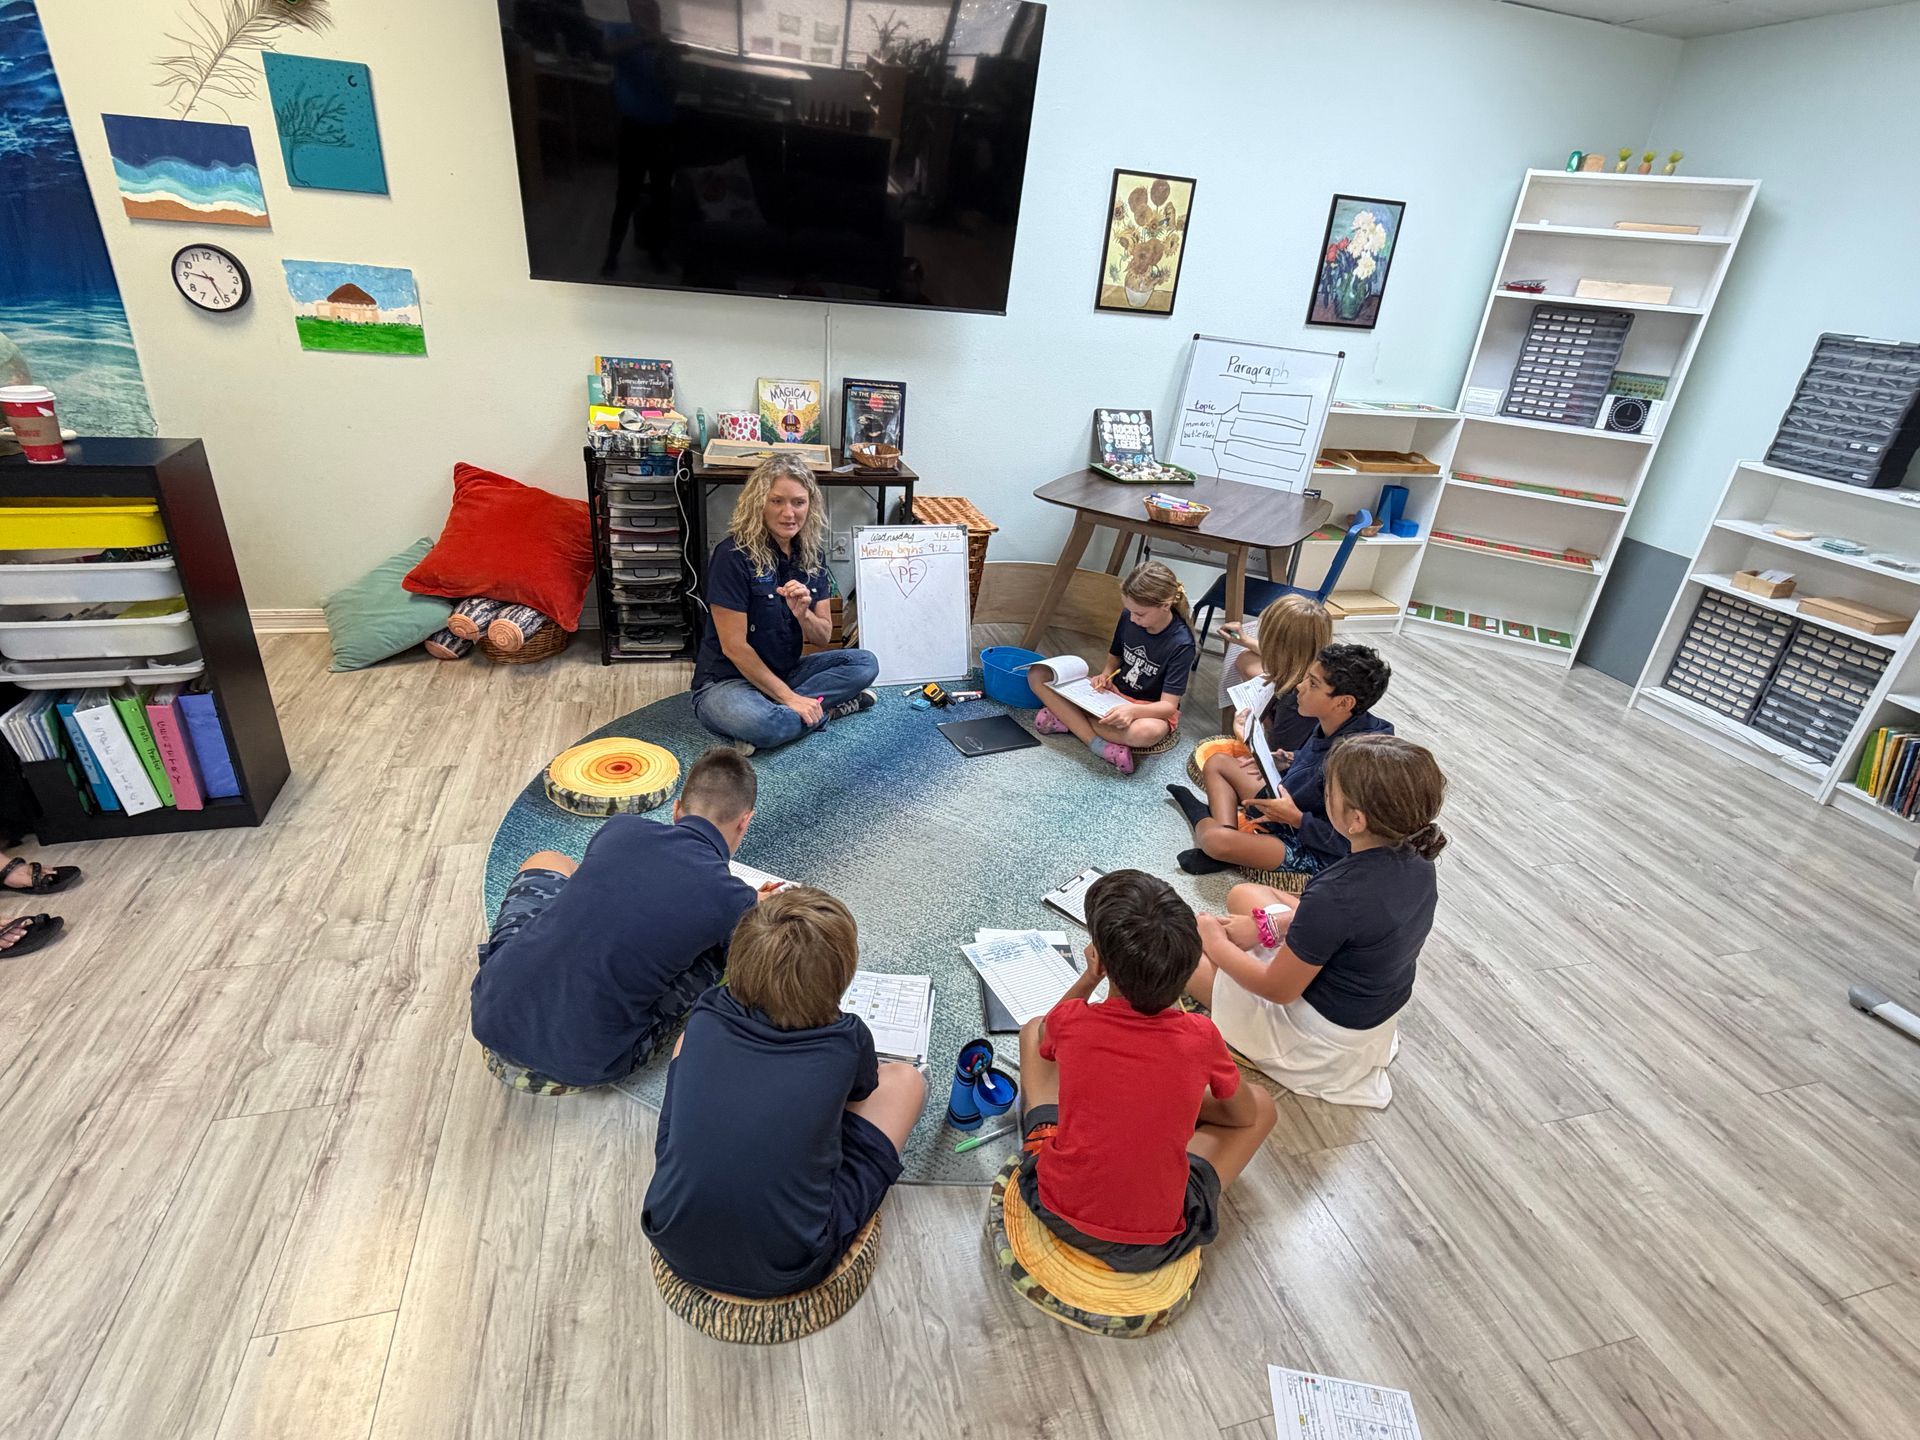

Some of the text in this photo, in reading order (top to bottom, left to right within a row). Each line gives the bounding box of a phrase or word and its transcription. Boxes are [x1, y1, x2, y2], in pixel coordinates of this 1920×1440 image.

[191, 254, 200, 262] 11
[202, 252, 212, 260] 12
[217, 256, 222, 264] 1
[183, 261, 193, 270] 10
[226, 265, 233, 273] 2
[183, 271, 190, 280] 9
[232, 276, 239, 285] 3
[190, 283, 197, 292] 8
[200, 291, 206, 300] 7
[224, 294, 231, 303] 5
[213, 296, 220, 305] 6
[1226, 355, 1290, 387] Paragraph
[650, 377, 665, 388] Today
[770, 387, 811, 402] MAGICAL
[871, 392, 900, 400] BEGINNING
[781, 397, 799, 409] YET
[1194, 400, 1216, 413] topic
[861, 542, 950, 560] Meeting begins 9:12
[898, 566, 919, 583] PE
[1144, 662, 1159, 676] LIFE
